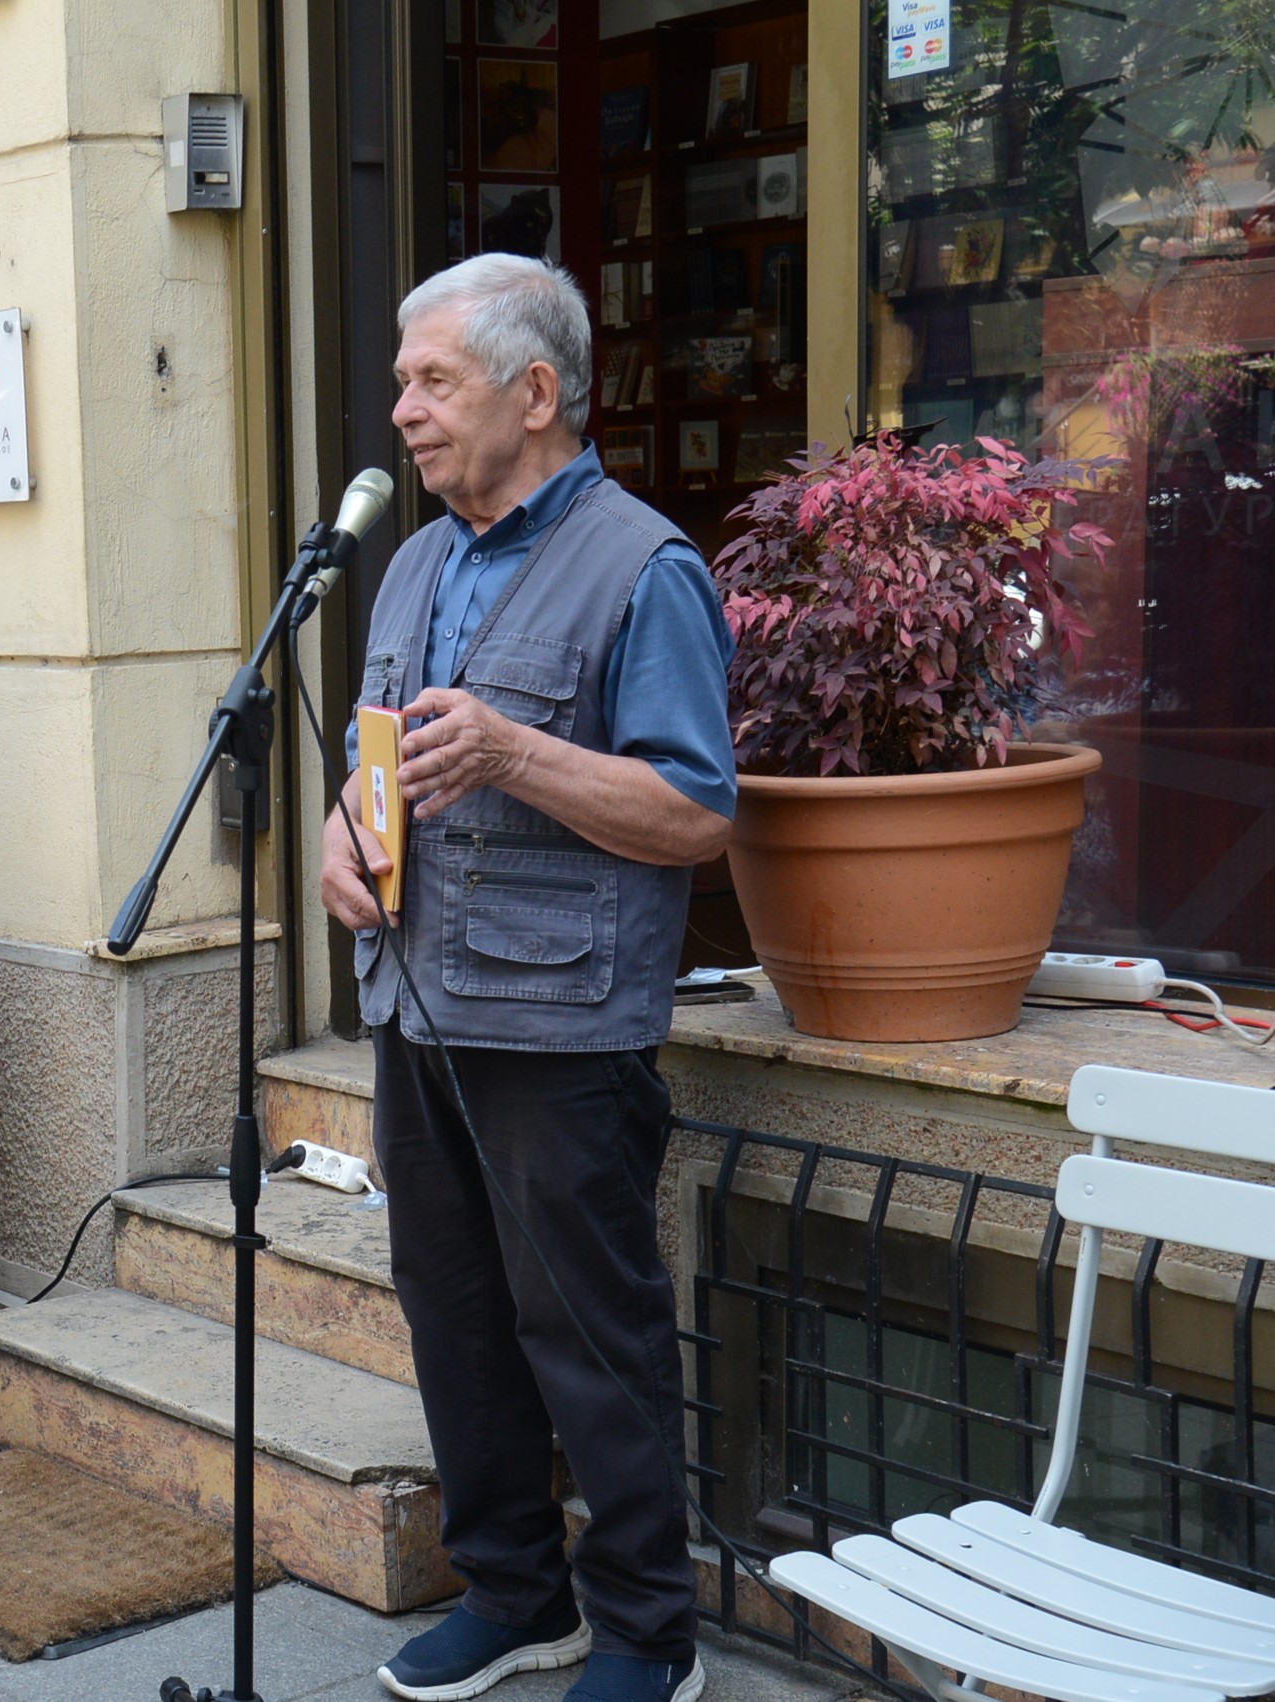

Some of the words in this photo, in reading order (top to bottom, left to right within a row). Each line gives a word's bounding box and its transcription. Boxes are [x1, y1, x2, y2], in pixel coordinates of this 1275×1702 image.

[902, 3, 918, 11] Visa
[896, 24, 914, 34] VISA
[924, 18, 945, 31] VISA
